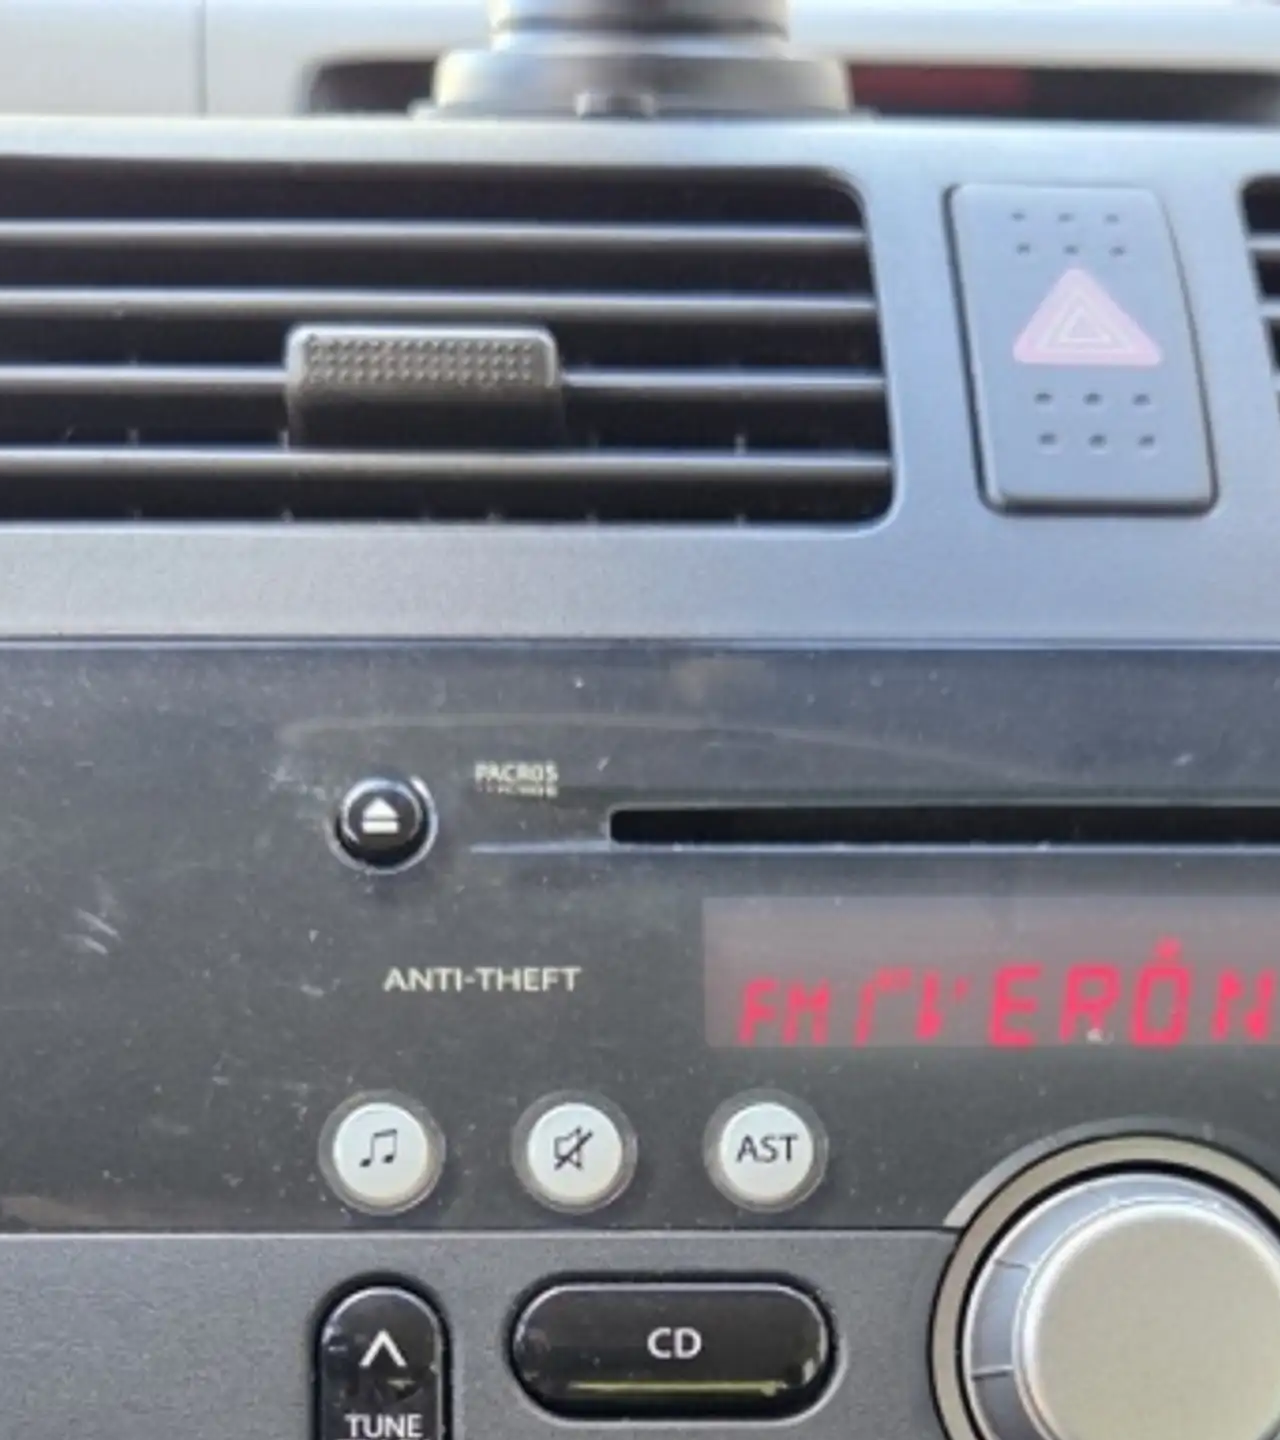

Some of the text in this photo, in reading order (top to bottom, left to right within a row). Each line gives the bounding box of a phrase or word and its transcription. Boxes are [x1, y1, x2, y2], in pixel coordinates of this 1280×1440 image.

[382, 966, 582, 992] ANTI-THEFT
[736, 1133, 800, 1164] AST
[647, 1326, 703, 1360] CD
[343, 1412, 424, 1439] TUNE
